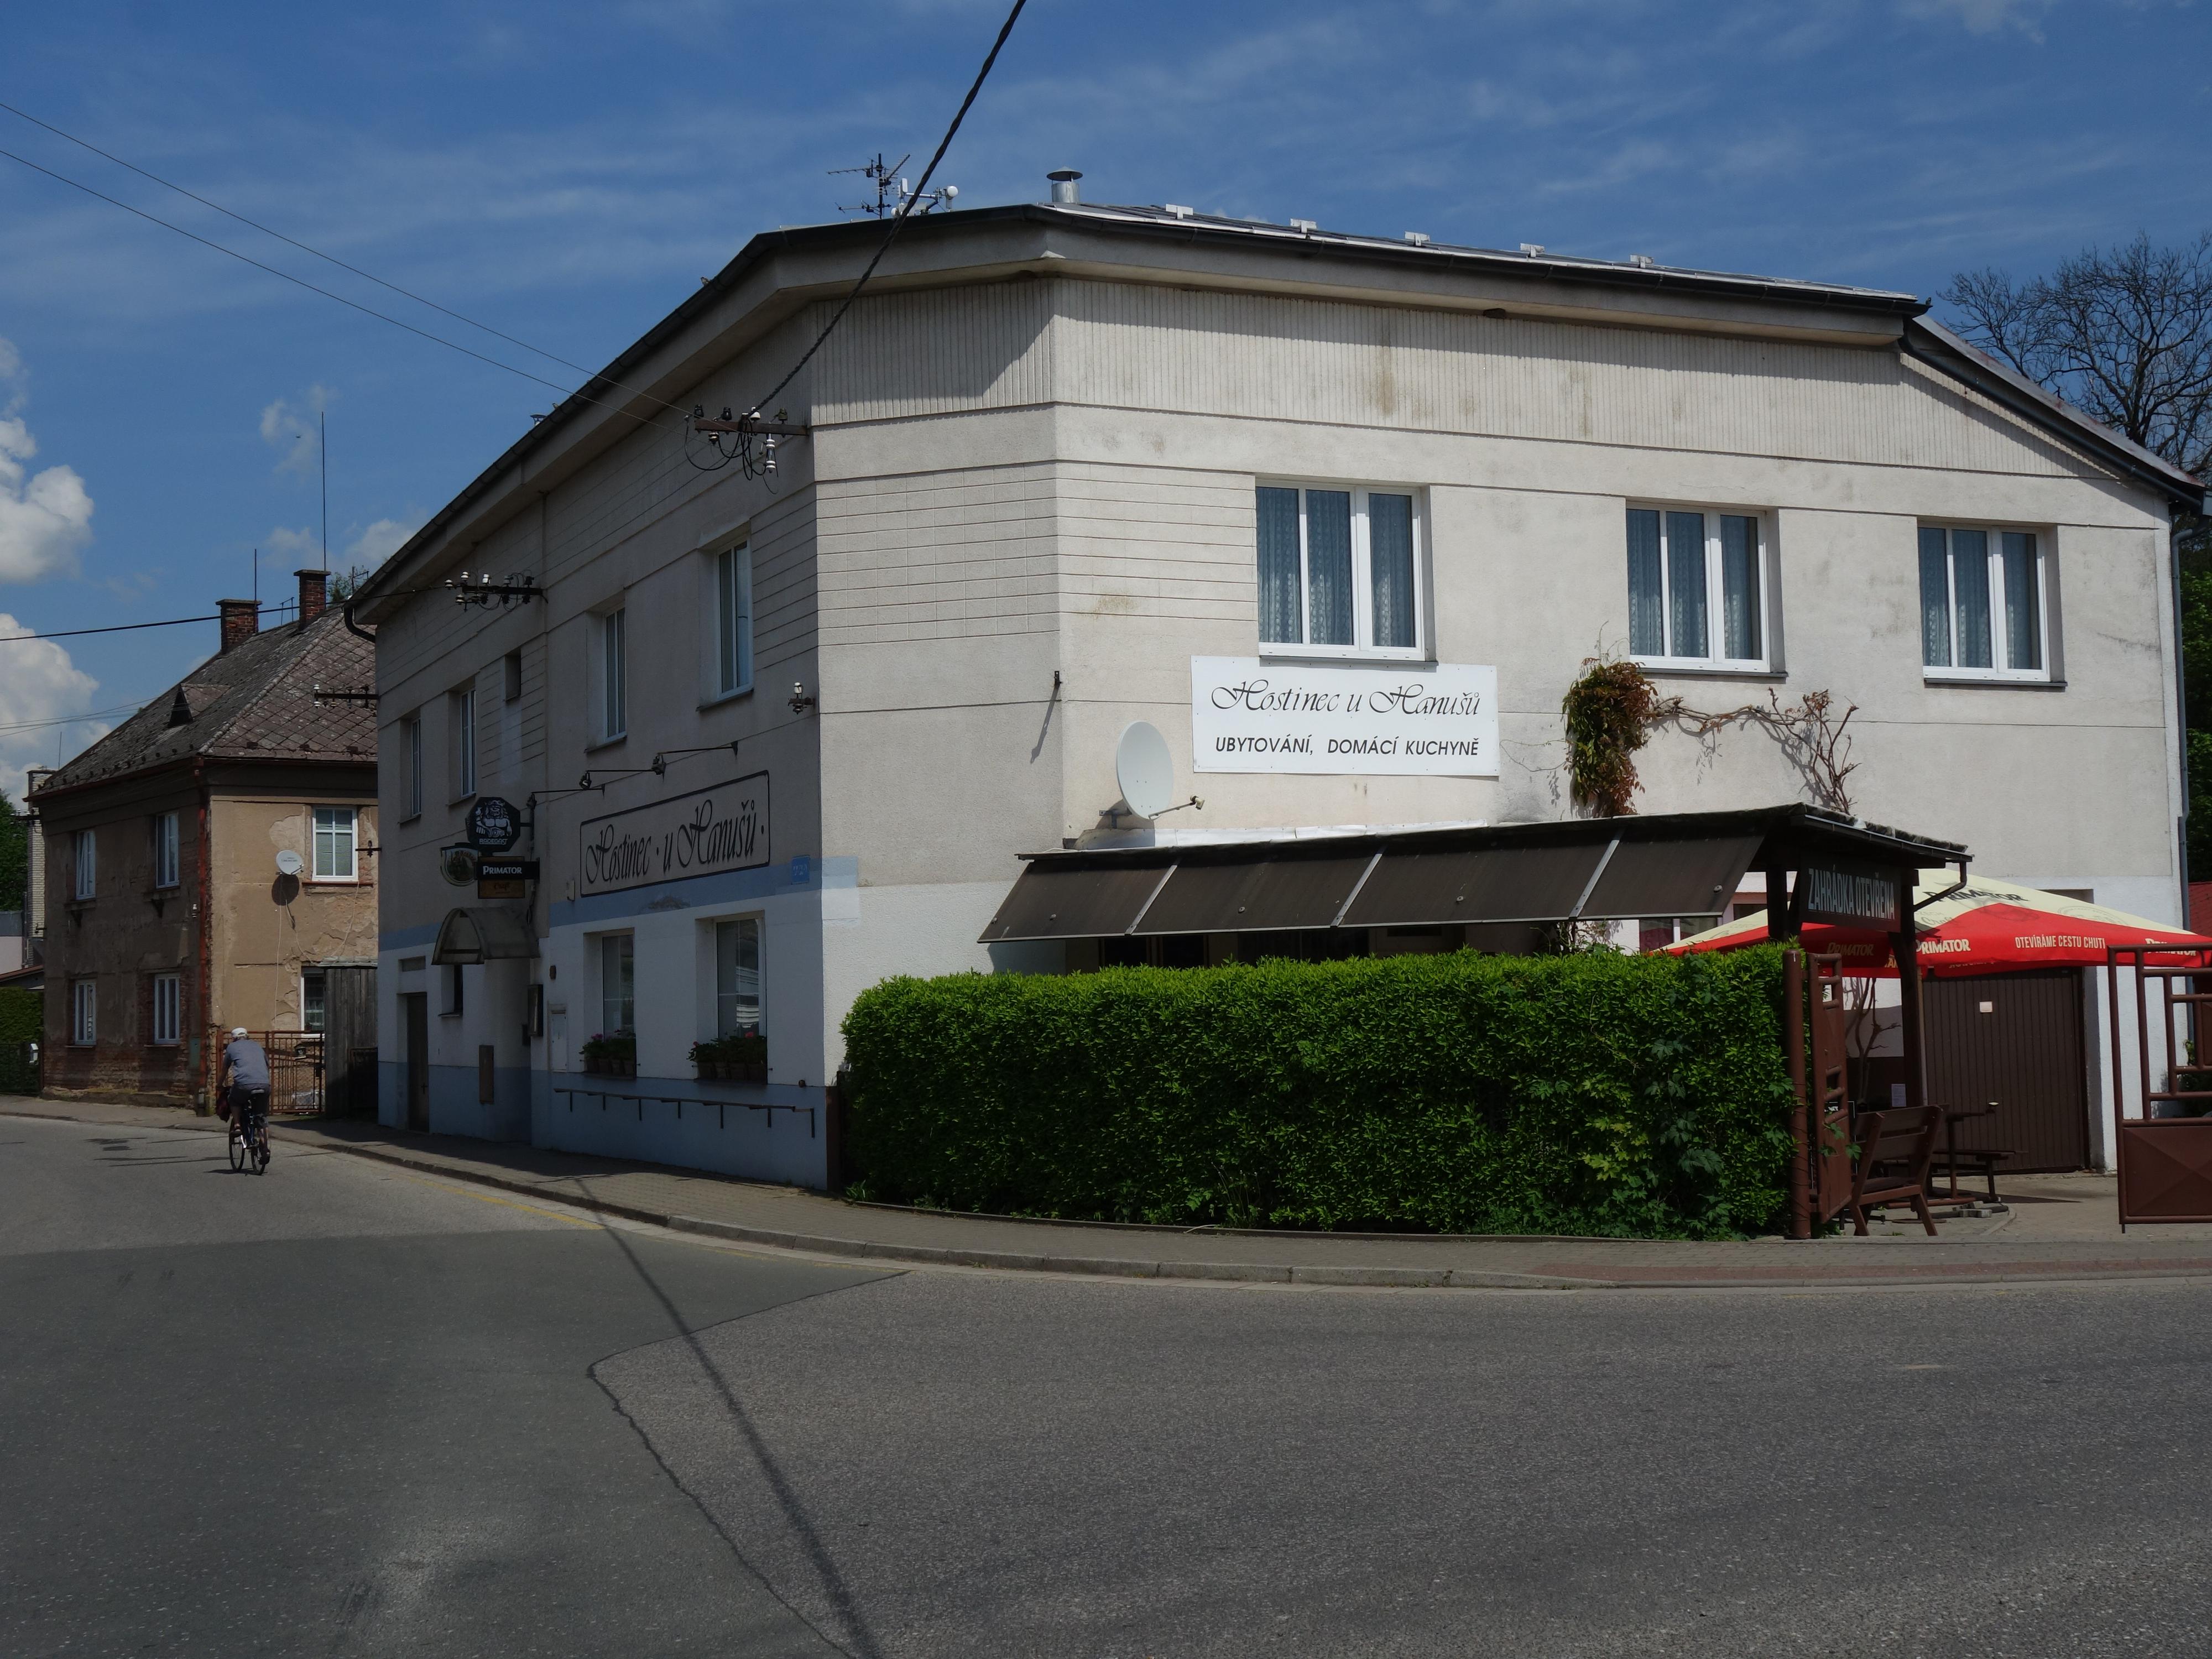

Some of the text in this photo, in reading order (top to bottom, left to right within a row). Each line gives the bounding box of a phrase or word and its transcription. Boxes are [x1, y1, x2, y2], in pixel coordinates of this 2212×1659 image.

[1211, 679, 1481, 716] Hostinec u Hanušů
[1215, 734, 1479, 757] UBYTOVÁNÍ, DOMÁCÍ KUCHYNĚ
[586, 799, 757, 884] Hostinec u Hanušů
[483, 865, 522, 875] PRIMATOR
[1808, 864, 1895, 920] ZAHRÁDKA OTEVŘENA
[2015, 933, 2105, 950] OTEVÍRÁME CESTU CHUTI
